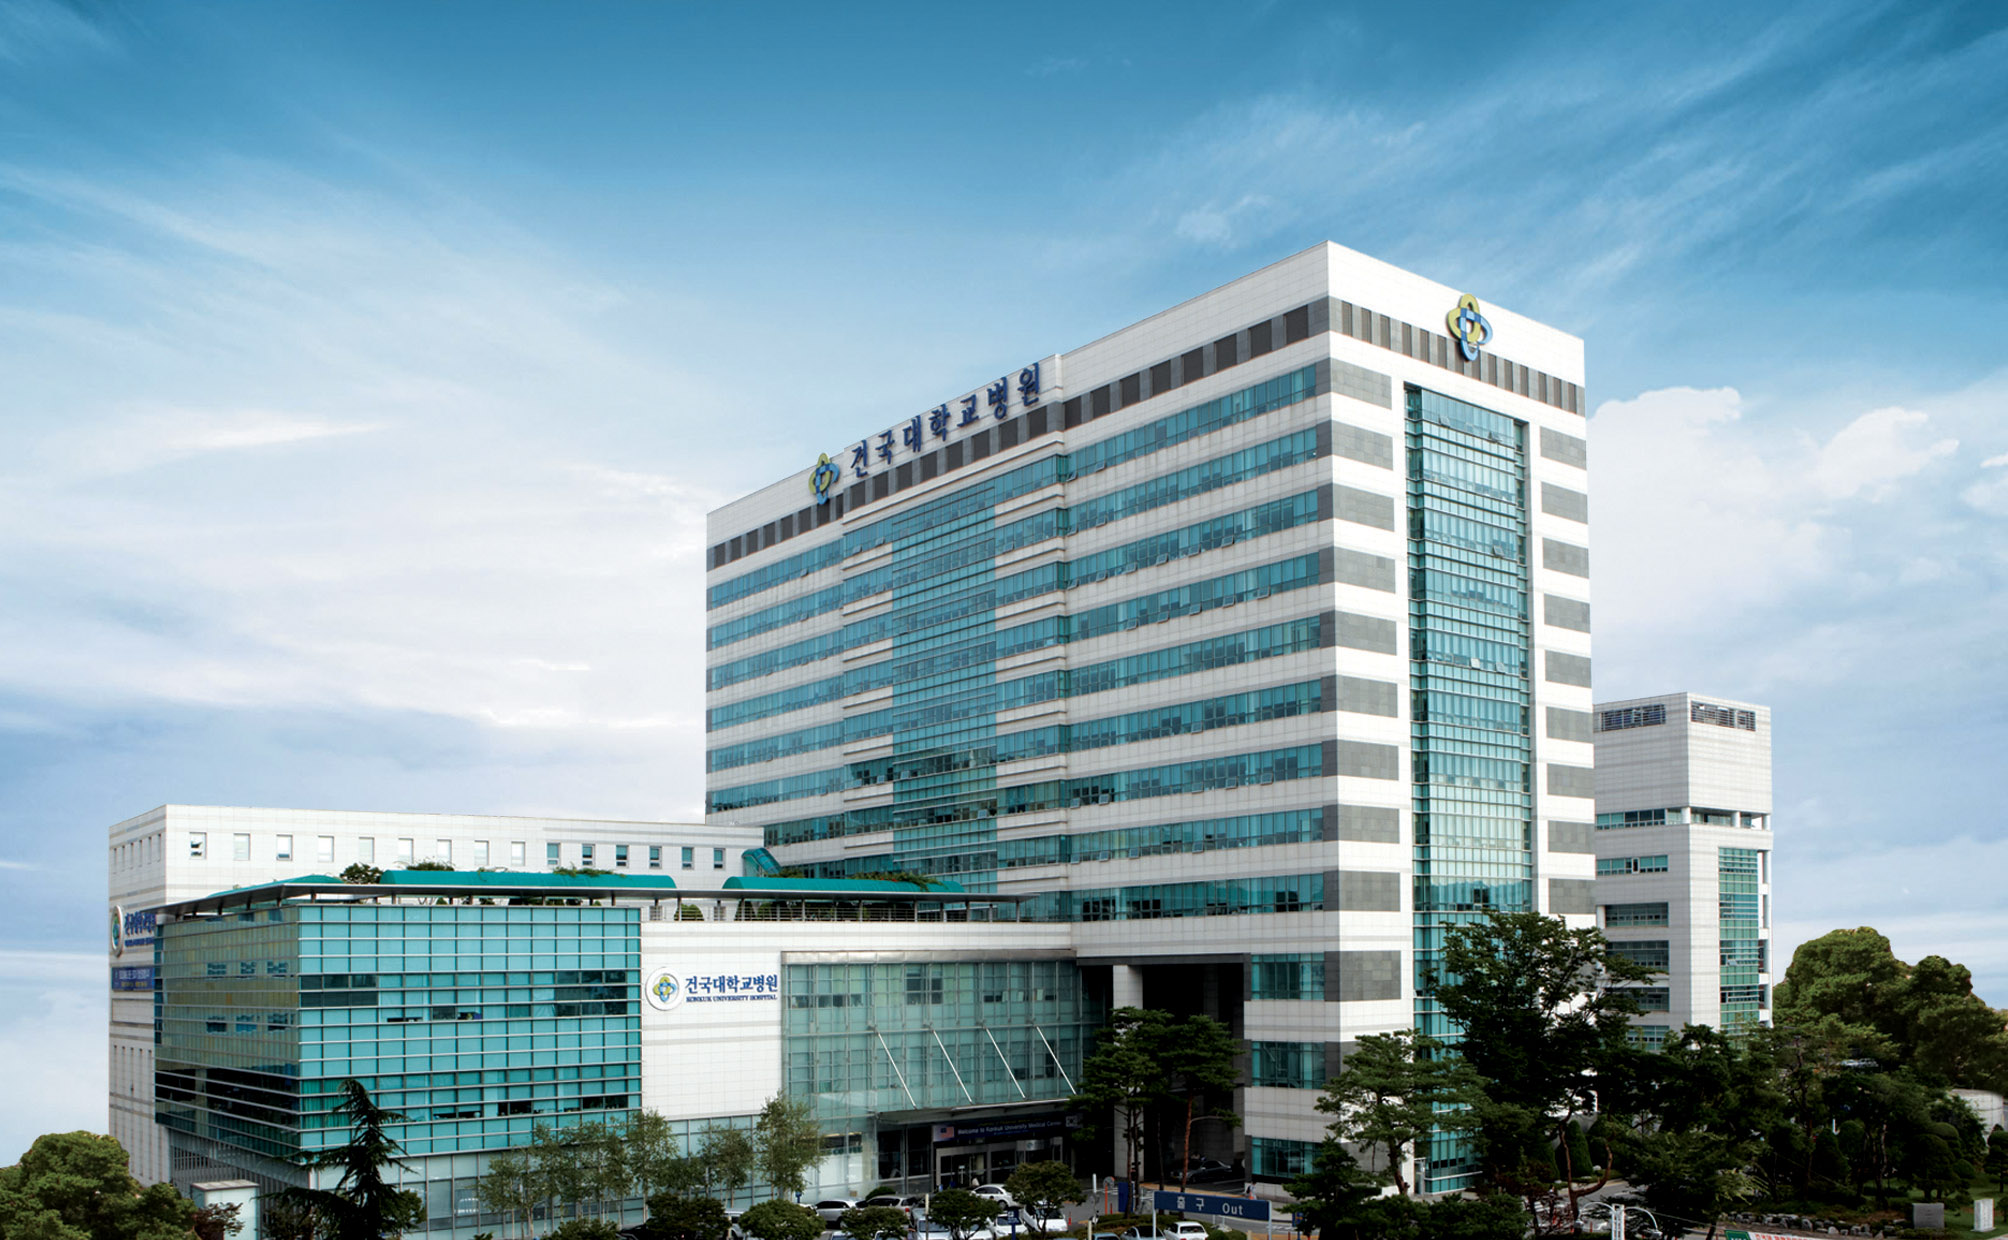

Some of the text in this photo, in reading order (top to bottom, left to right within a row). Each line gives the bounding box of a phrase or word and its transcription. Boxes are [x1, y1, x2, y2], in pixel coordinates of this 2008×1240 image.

[851, 362, 1040, 478] 건국대학교병원
[685, 974, 778, 994] 건국대학교병원
[1004, 1123, 1027, 1131] University
[1222, 1202, 1244, 1216] Out
